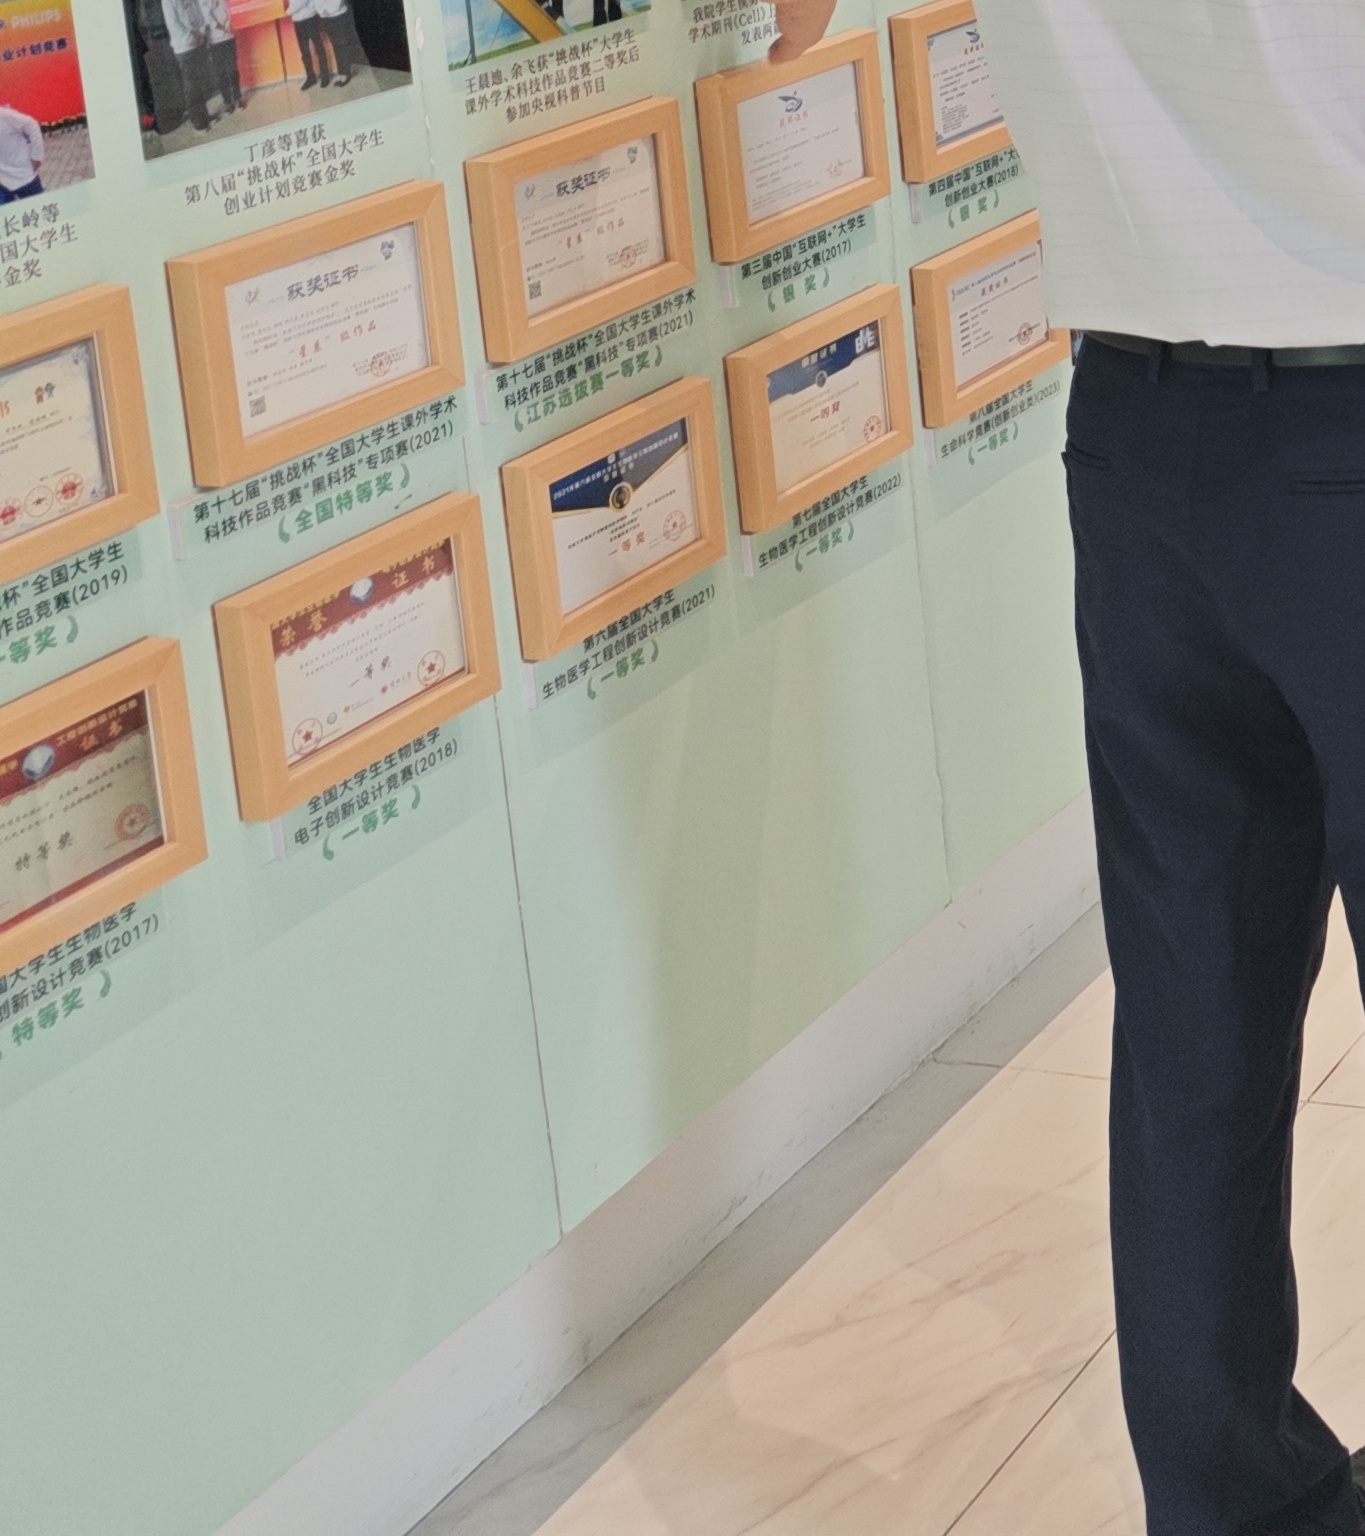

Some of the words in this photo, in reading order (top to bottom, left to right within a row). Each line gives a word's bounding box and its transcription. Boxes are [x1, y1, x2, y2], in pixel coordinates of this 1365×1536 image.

[242, 122, 328, 163] 丁彦等喜获
[223, 159, 356, 216] 创业计划竞赛金奖
[0, 202, 61, 241] 长岭等
[0, 257, 43, 289] 金奖
[294, 465, 396, 535] 全国特等奖
[806, 526, 844, 558] 一等奖
[0, 541, 125, 612] 杯”全国大学生
[601, 648, 646, 683] 一等奖
[294, 737, 459, 847] 电子创新设计竞赛(2018)
[306, 726, 441, 816] 全国大学生生物医学
[341, 796, 400, 841] 一等奖
[11, 984, 85, 1047] 特等奖
